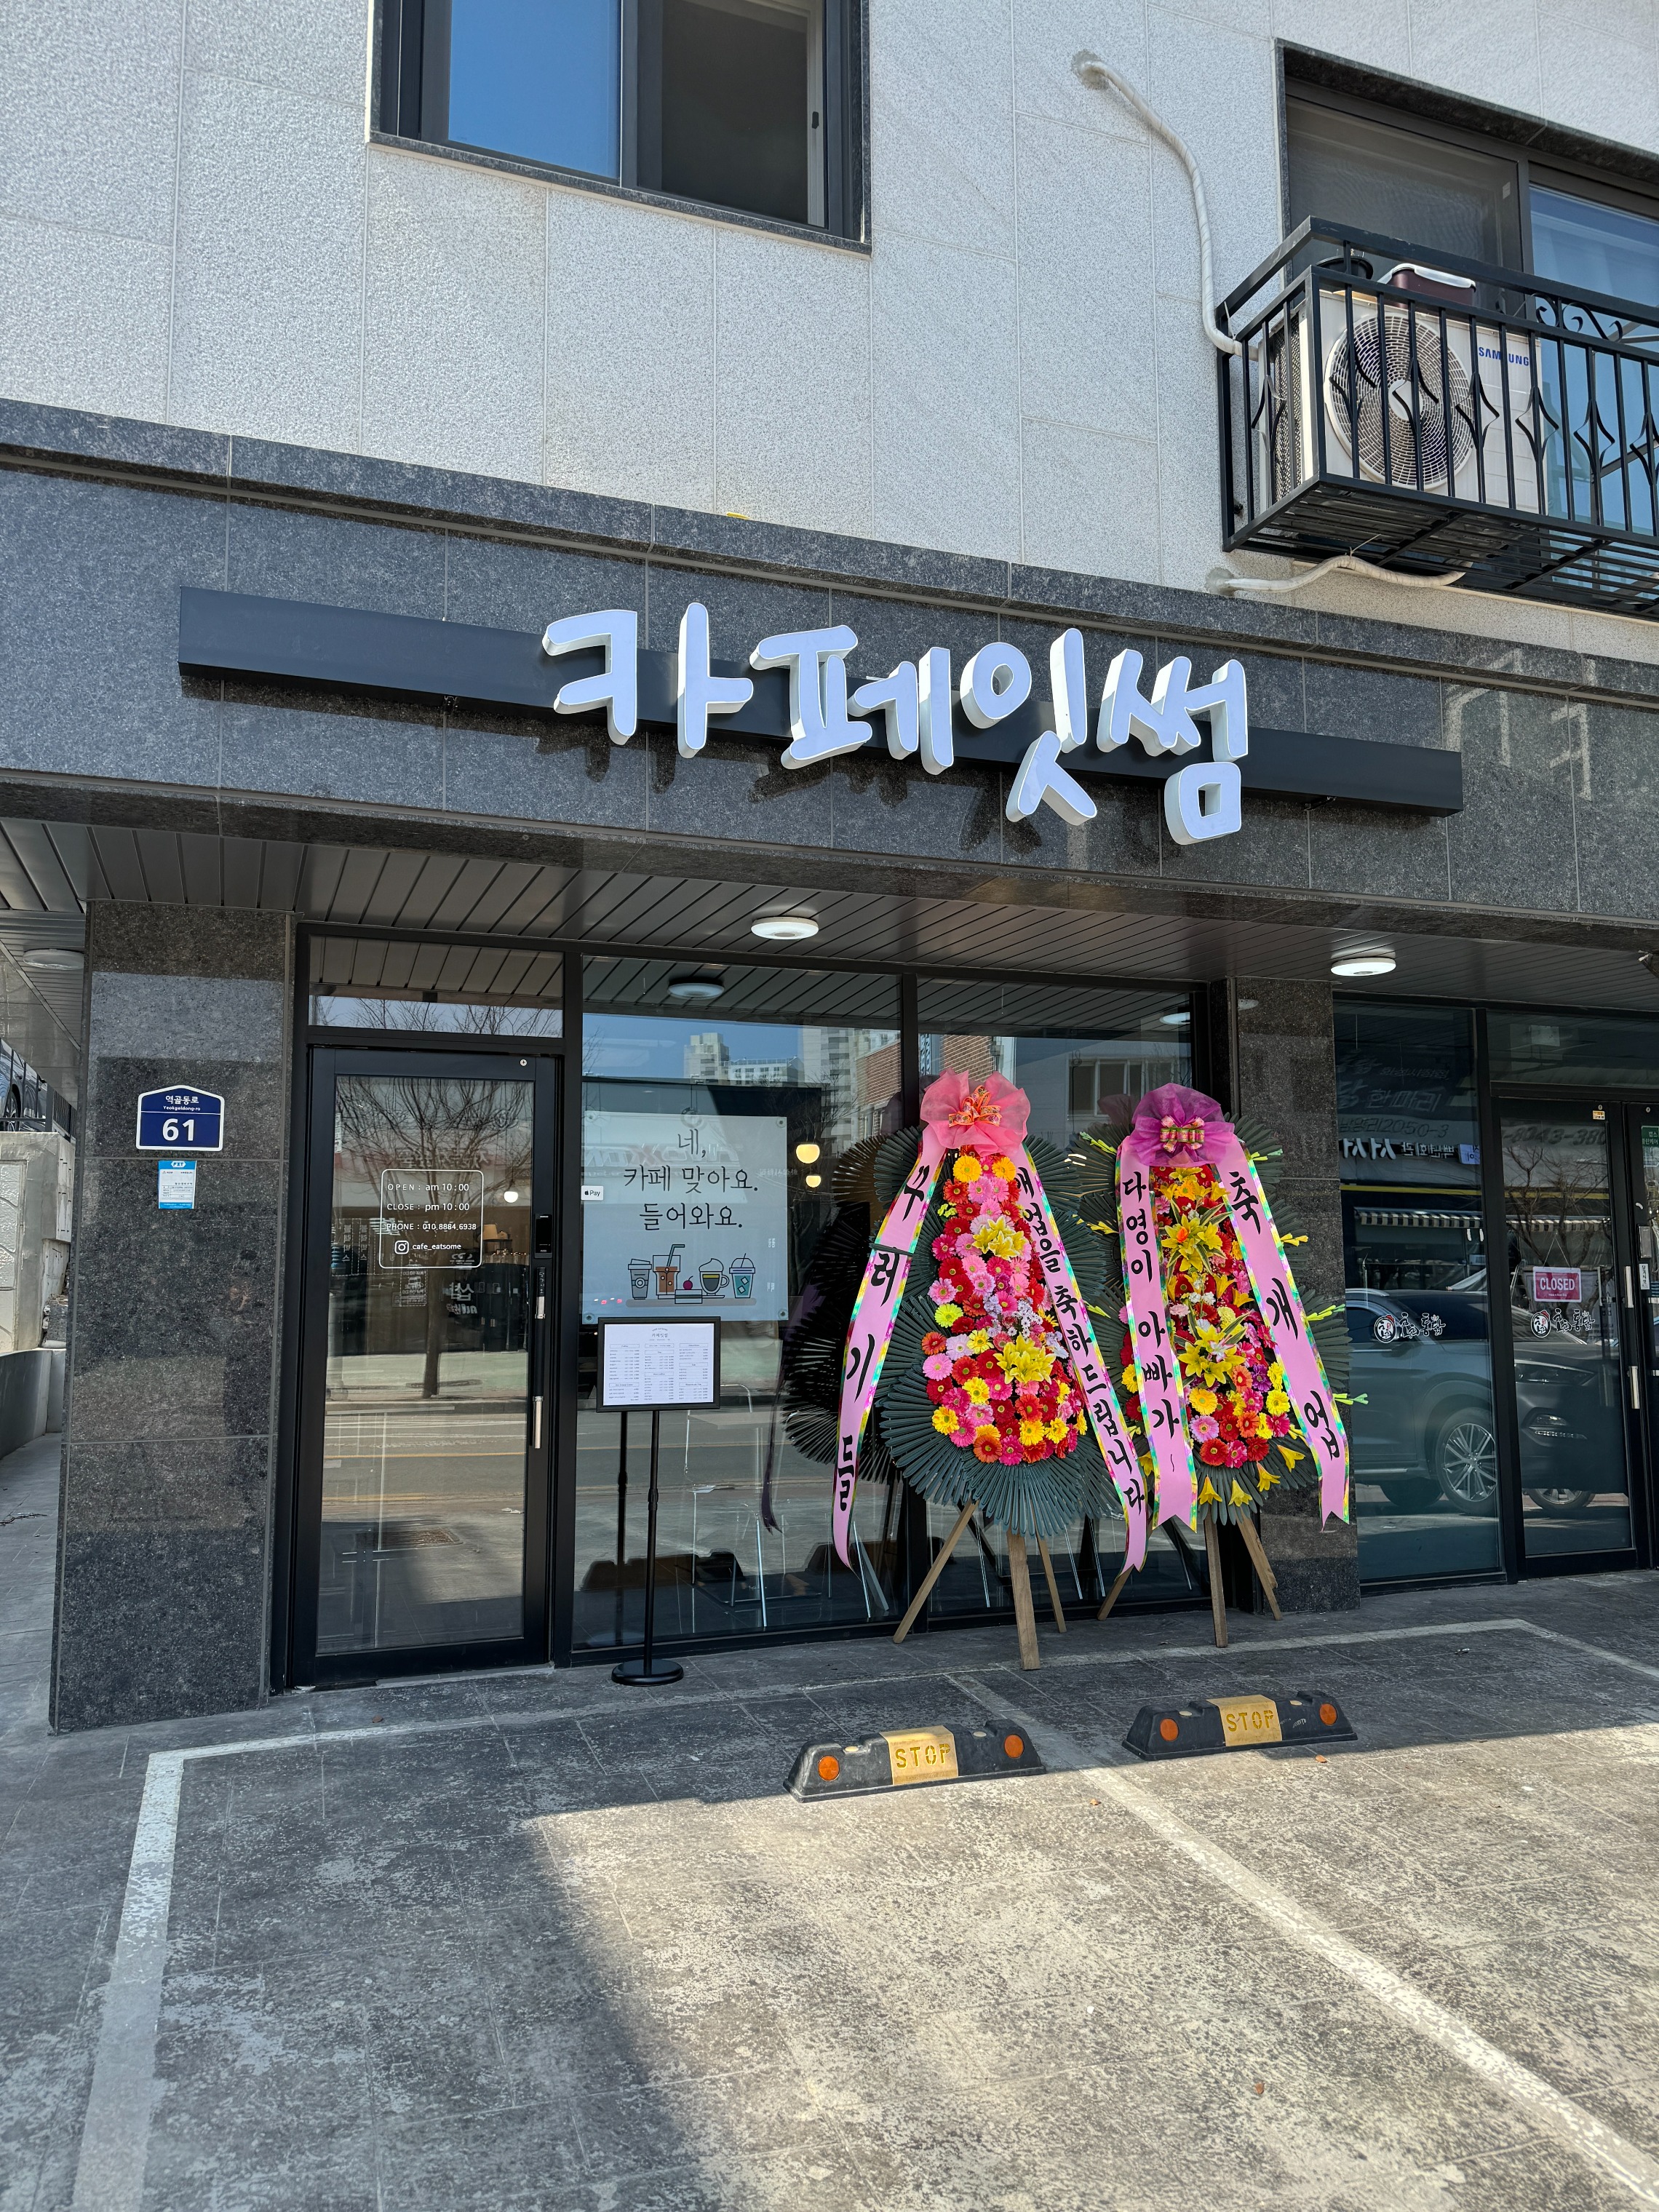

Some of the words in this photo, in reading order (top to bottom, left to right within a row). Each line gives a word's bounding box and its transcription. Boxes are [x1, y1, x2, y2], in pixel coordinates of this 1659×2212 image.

[1479, 346, 1529, 367] SAMUNG
[541, 602, 1249, 845] 카페잇썸
[165, 1095, 199, 1105] 역골동로
[162, 1118, 194, 1142] 61
[677, 1129, 707, 1158] 네,
[442, 1183, 469, 1191] 10:00
[623, 1164, 671, 1192] 카페
[682, 1166, 758, 1194] 맞아요.
[425, 1204, 439, 1212] pm
[442, 1203, 470, 1211] 10:00
[640, 1203, 743, 1230] 들어와요.
[1123, 1171, 1154, 1284] 다영이
[412, 1243, 462, 1251] cafe_eatsome
[1540, 1278, 1575, 1291] CLOSED
[1054, 1285, 1146, 1515] 축하드립니다
[1226, 1710, 1274, 1732] STOP
[895, 1743, 951, 1768] STOP
